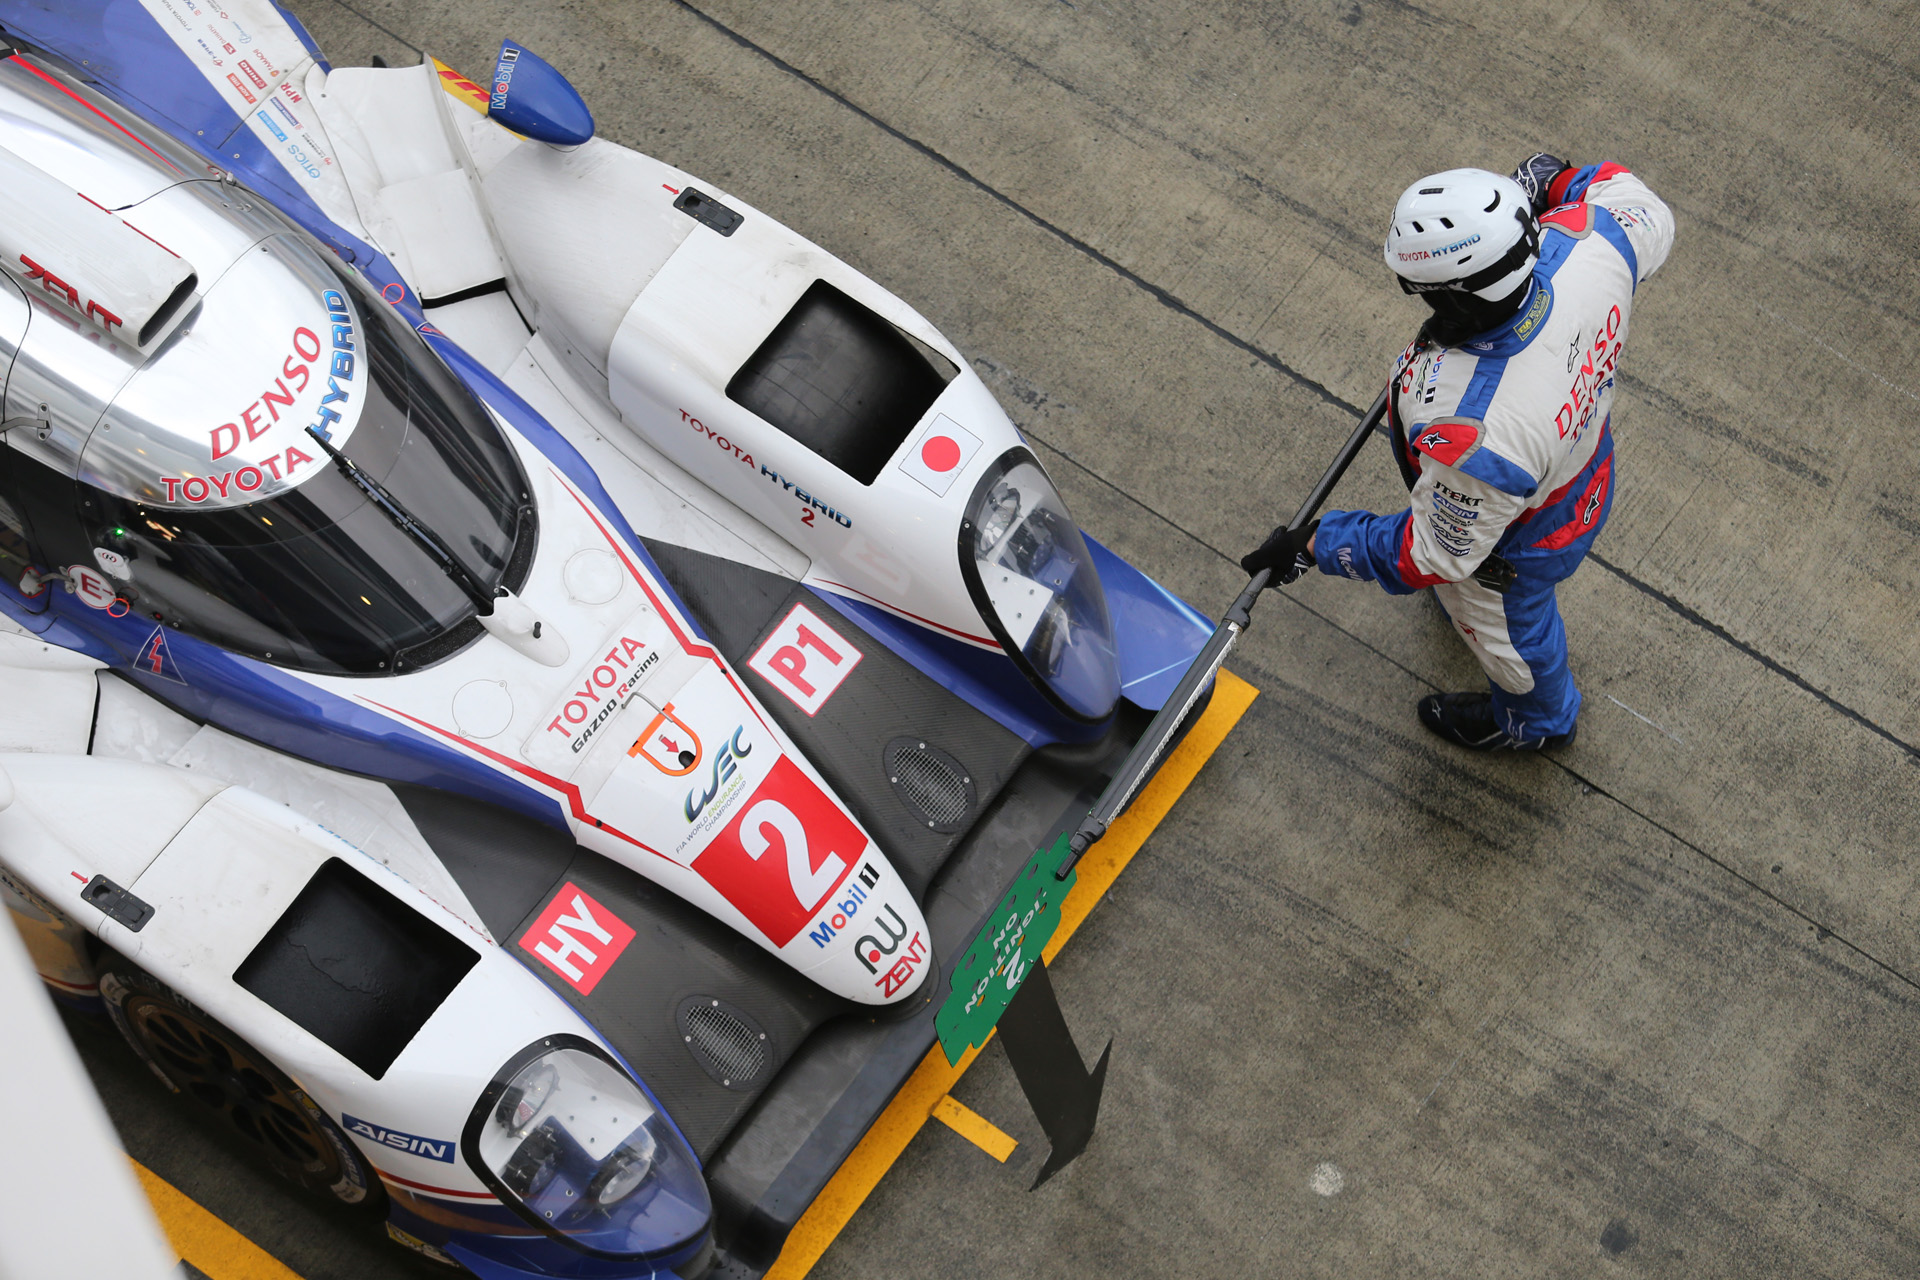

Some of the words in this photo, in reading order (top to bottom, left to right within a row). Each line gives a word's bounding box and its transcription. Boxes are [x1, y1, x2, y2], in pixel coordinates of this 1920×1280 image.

[239, 61, 260, 82] HINO
[491, 62, 515, 109] Mobil
[502, 47, 520, 62] 1
[280, 82, 303, 103] NPR
[287, 144, 320, 179] OTICS
[1398, 250, 1431, 262] TOYOTA
[1431, 233, 1481, 258] HYBRID
[19, 253, 123, 333] ZENT
[209, 326, 321, 462] DENSO
[309, 289, 356, 443] HYBRID
[1555, 304, 1621, 441] DENSO
[161, 446, 314, 503] TOYOTA
[678, 408, 755, 469] TOYOTA
[761, 463, 852, 529] HYBRID
[1433, 480, 1484, 507] JTEKT
[801, 507, 815, 528] 2
[1435, 496, 1475, 518] AISIN
[81, 572, 102, 600] E
[546, 636, 646, 738] TOYOTA
[767, 623, 844, 698] P1
[571, 699, 618, 754] GAZOO
[616, 651, 659, 699] Racing
[684, 724, 752, 824] WEC
[704, 780, 747, 832] CHAMPIONSHIP
[675, 841, 687, 855] FIA
[686, 815, 709, 842] WORLD
[707, 773, 744, 818] ENDURANCE
[739, 799, 847, 913] 2
[534, 894, 614, 983] HY
[809, 883, 867, 949] Mobil
[858, 862, 880, 890] 1
[875, 931, 927, 999] ZENT
[964, 900, 1040, 1015] IGNITION
[1003, 947, 1025, 991] 2
[352, 1122, 447, 1158] AISIN
